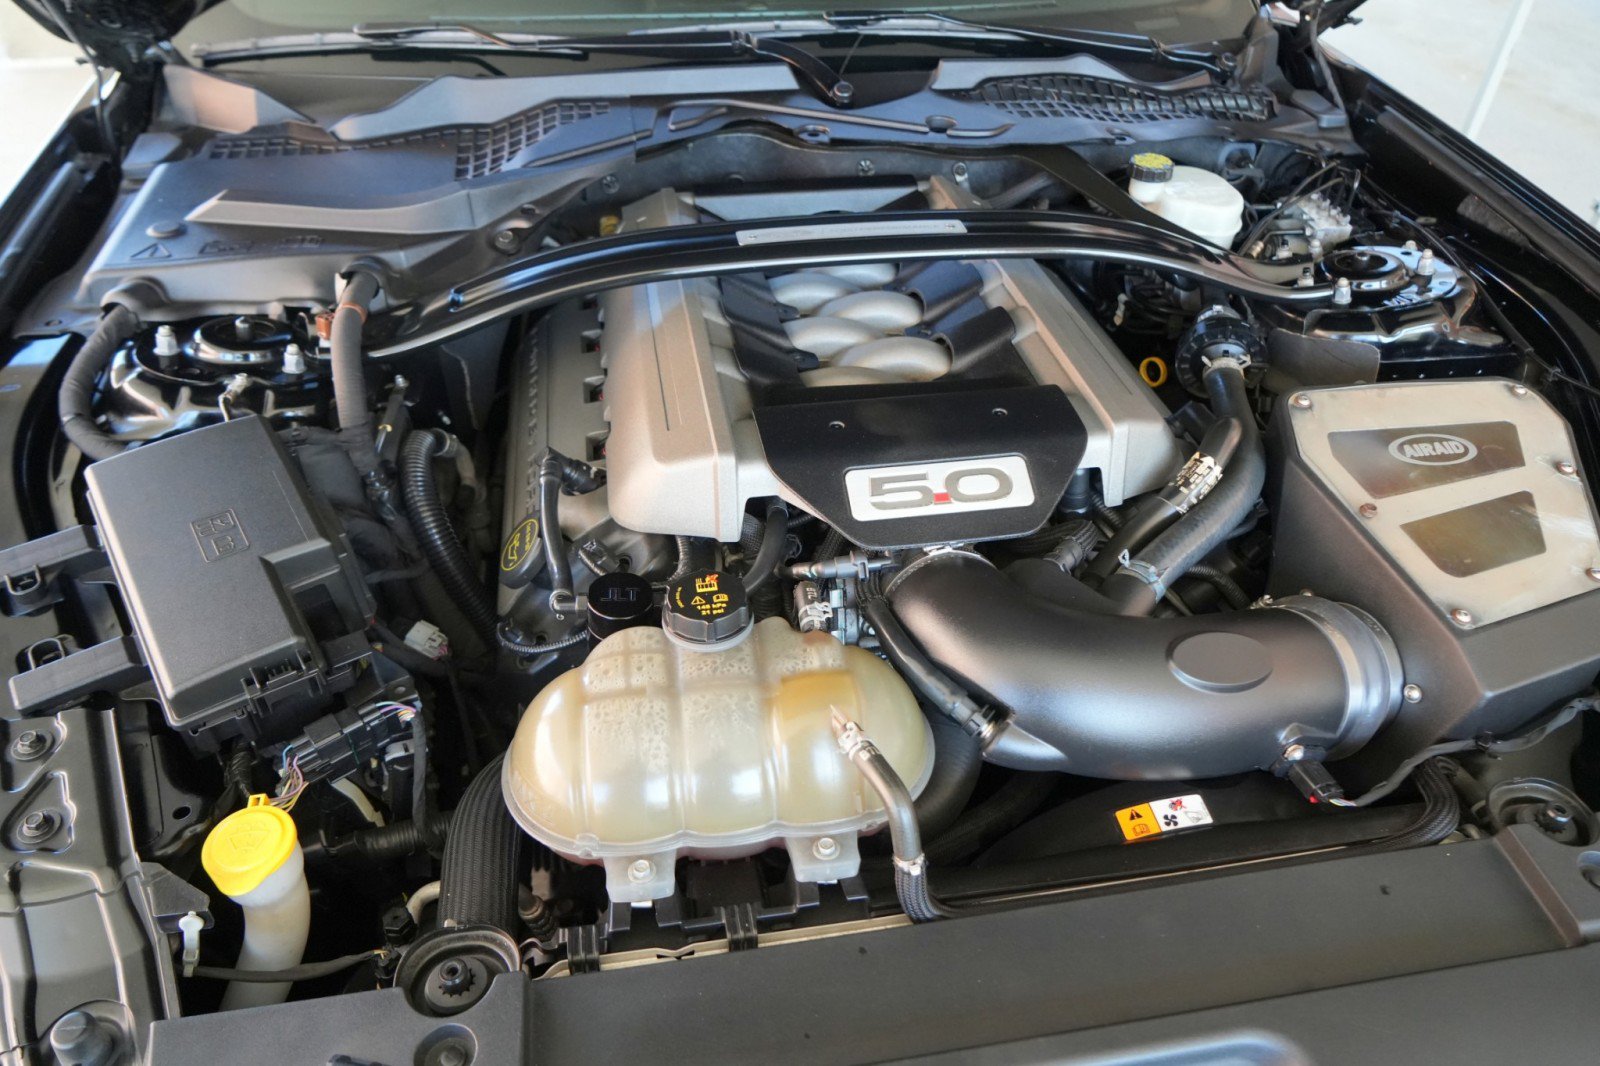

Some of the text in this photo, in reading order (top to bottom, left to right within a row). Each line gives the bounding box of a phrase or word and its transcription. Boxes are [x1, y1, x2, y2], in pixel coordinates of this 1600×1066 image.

[1403, 441, 1465, 458] AIRAID
[869, 467, 1014, 511] 5.0
[600, 587, 641, 601] JLT
